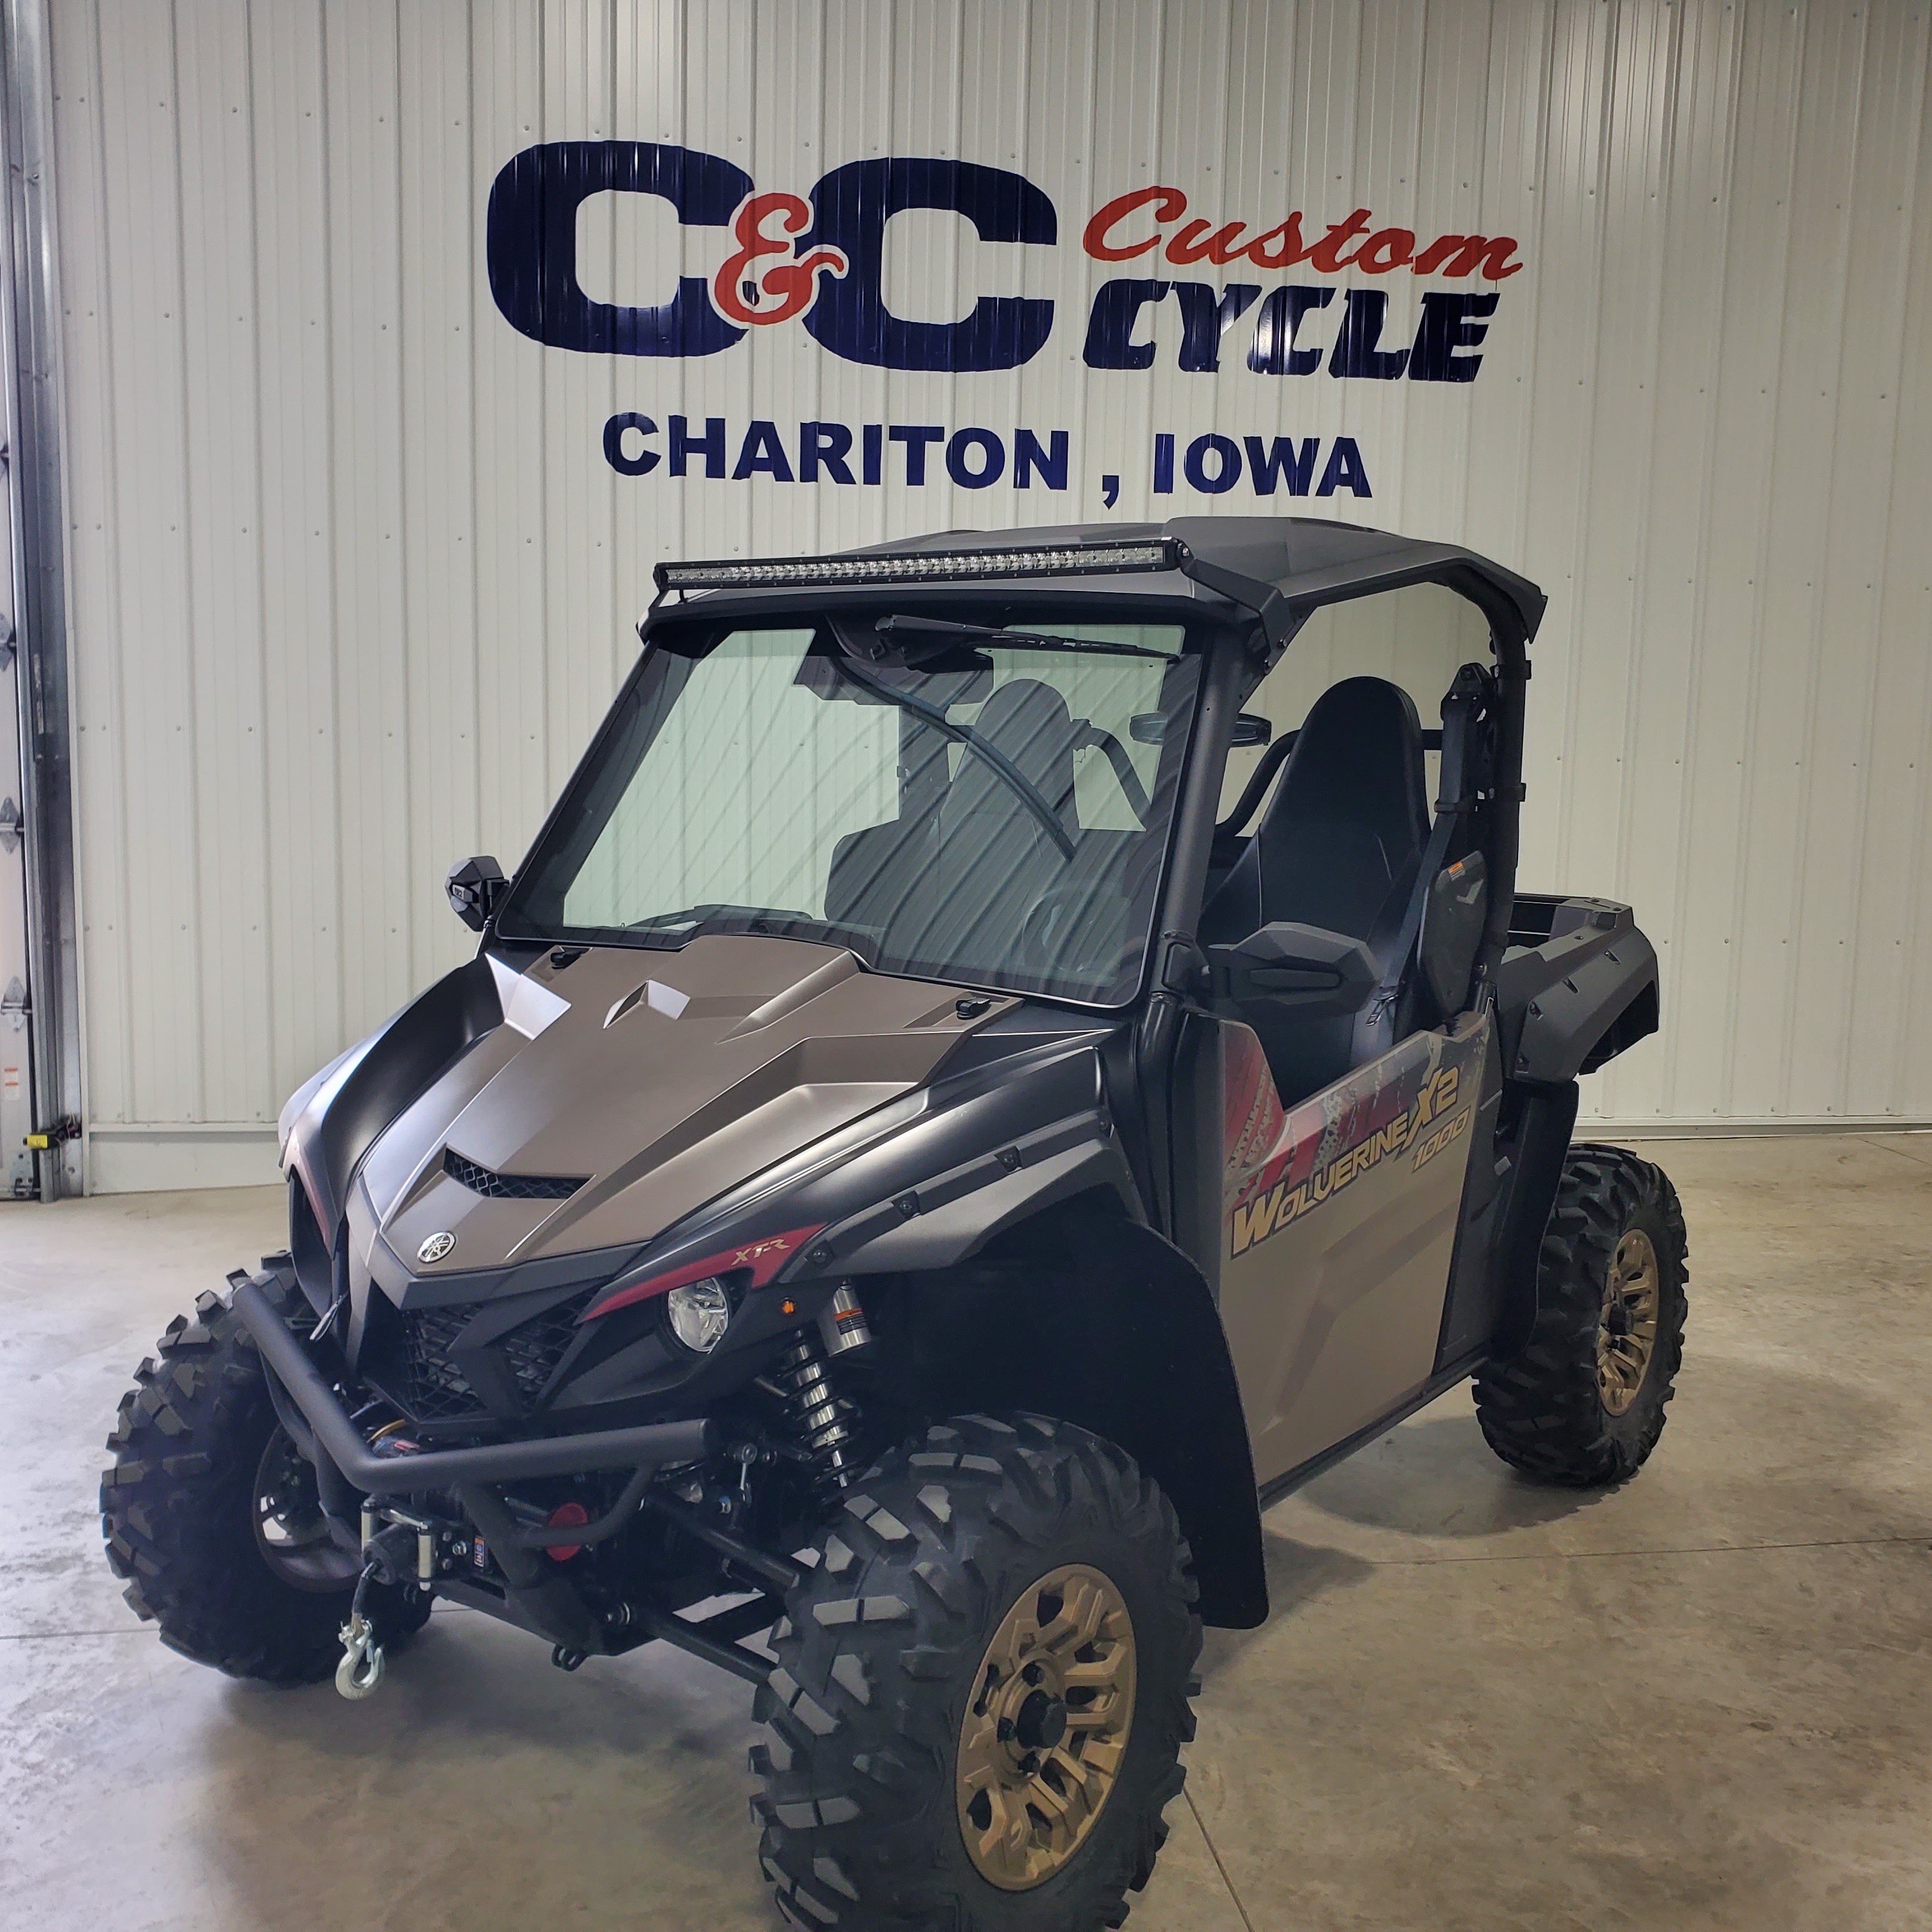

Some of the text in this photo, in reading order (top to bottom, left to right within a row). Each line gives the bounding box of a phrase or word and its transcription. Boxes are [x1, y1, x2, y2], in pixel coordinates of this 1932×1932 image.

[487, 140, 1057, 372] C&C
[1083, 185, 1523, 280] Custom
[1082, 279, 1500, 382] CYCLE
[603, 412, 1069, 490] CHARITON
[1154, 433, 1372, 498] IOWA
[1412, 1106, 1471, 1174] 1000
